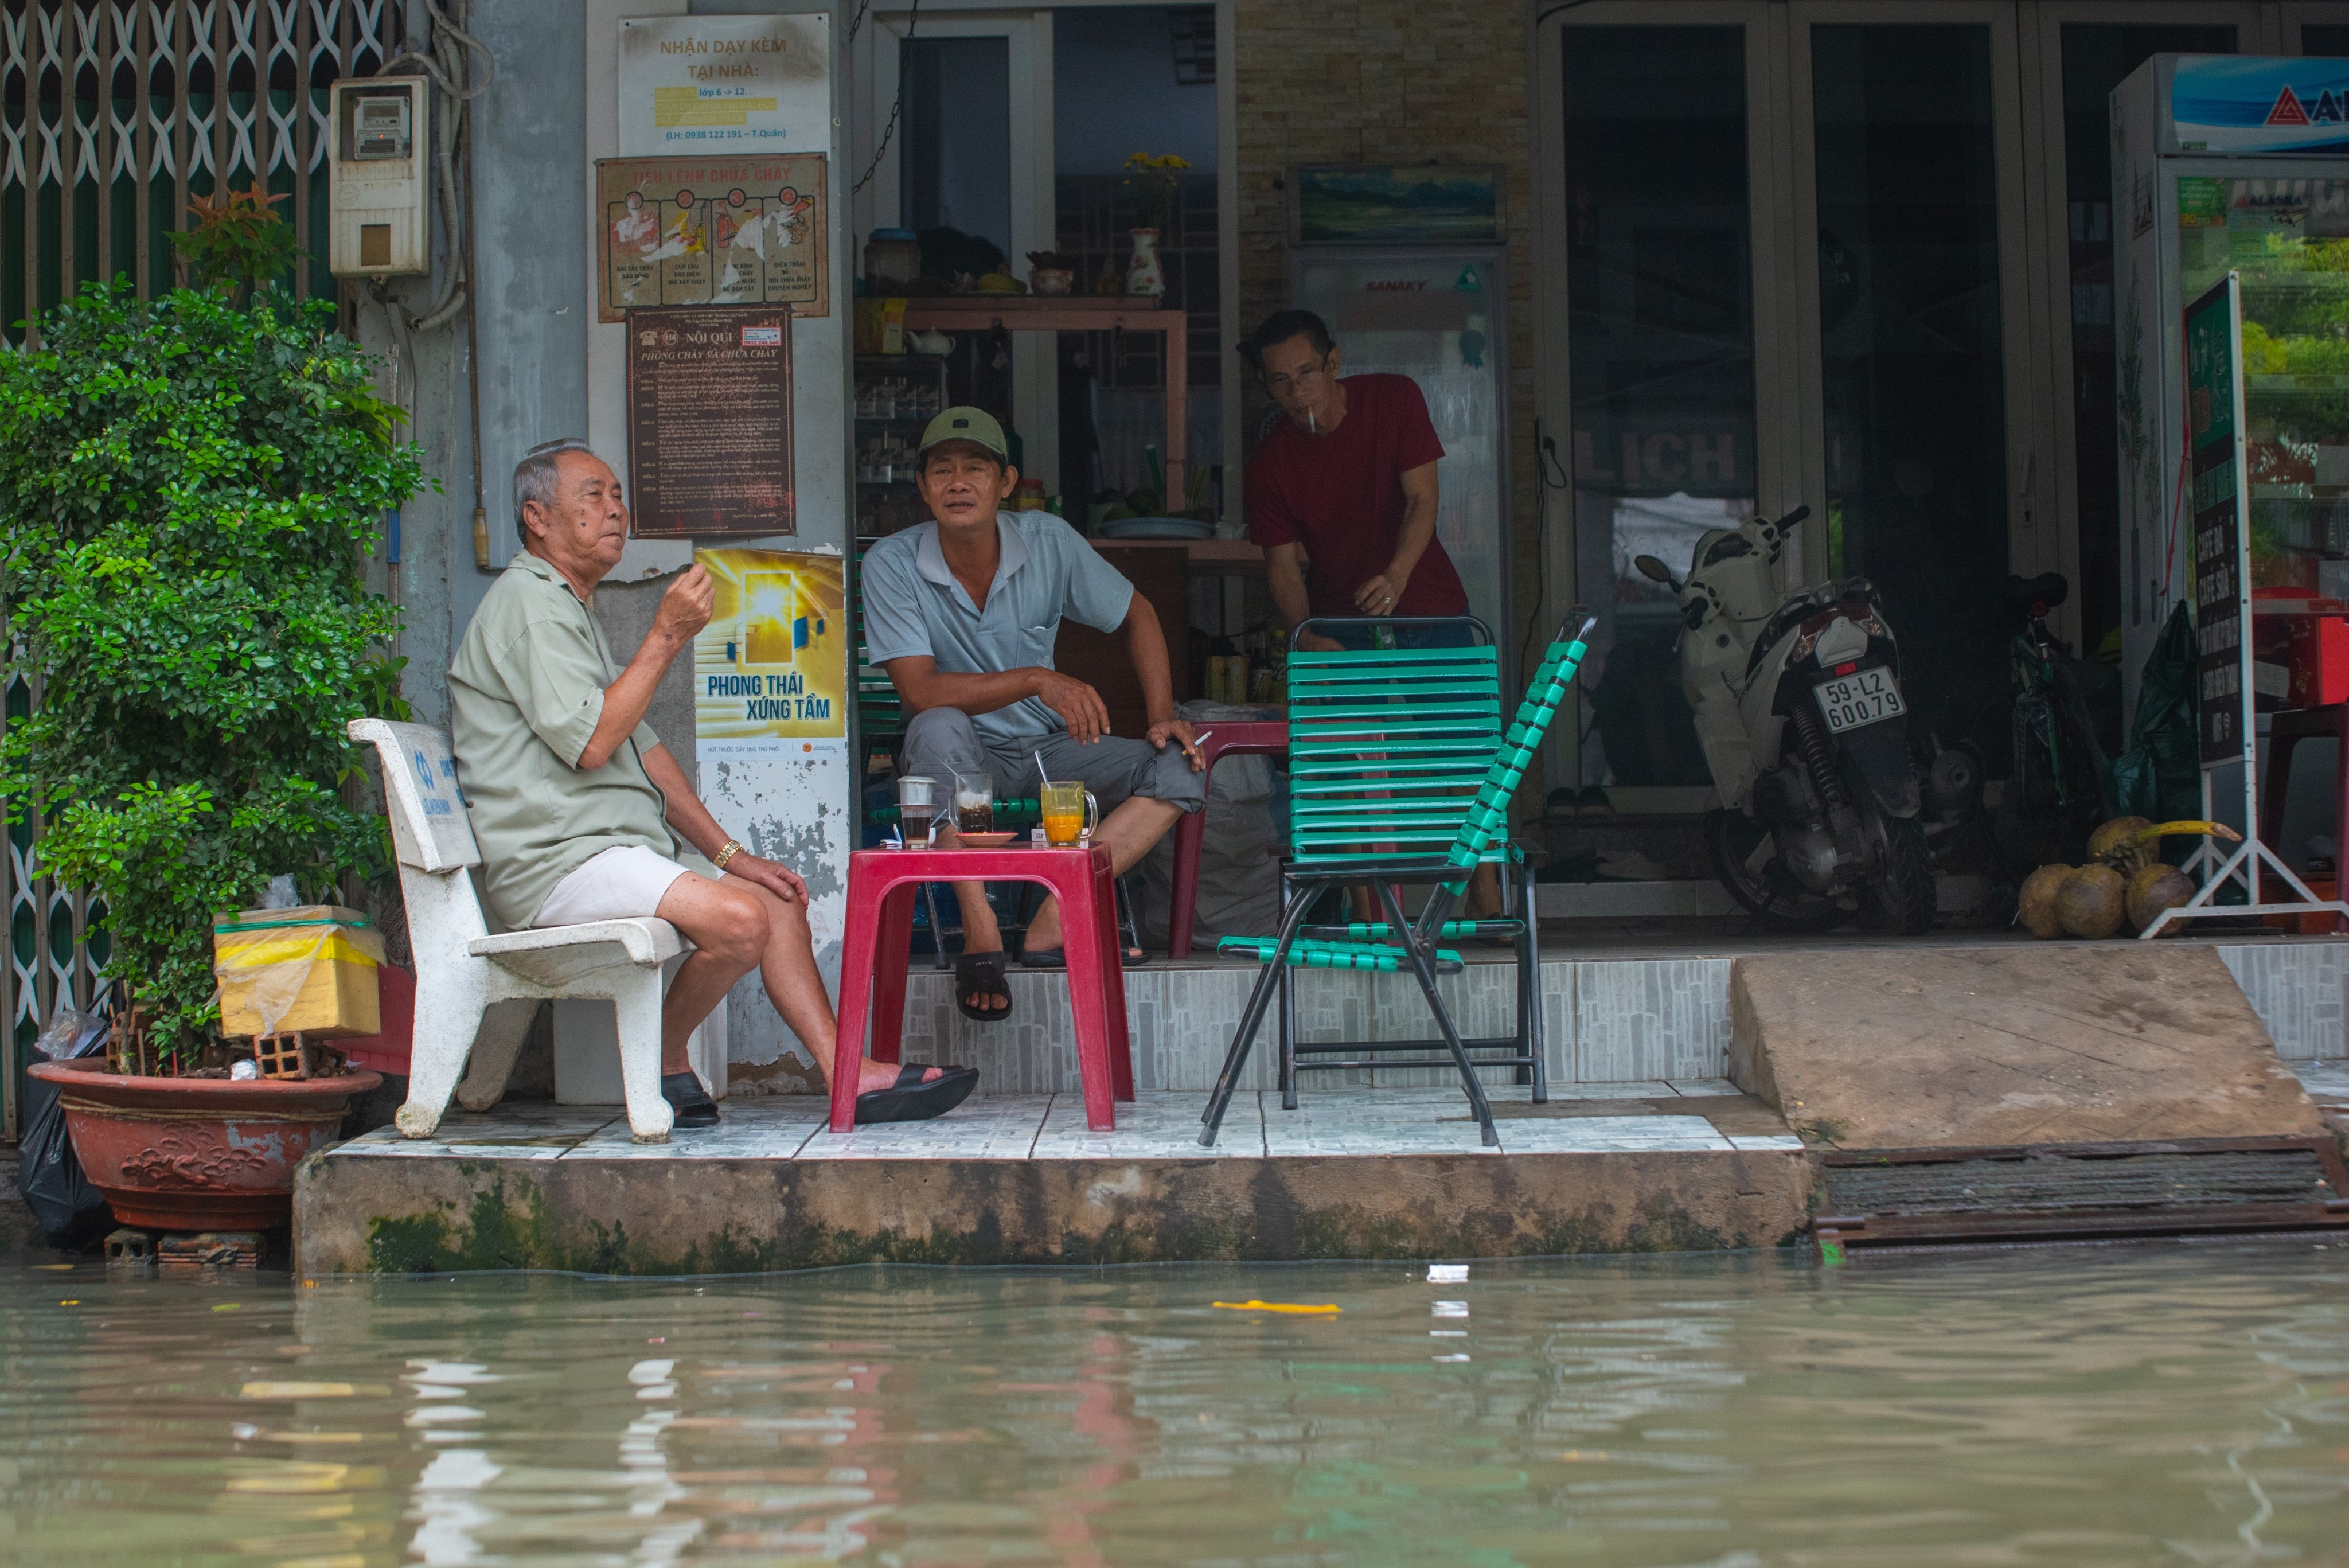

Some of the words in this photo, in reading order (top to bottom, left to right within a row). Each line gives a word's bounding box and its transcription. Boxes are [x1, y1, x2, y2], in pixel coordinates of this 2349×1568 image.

[660, 37, 707, 56] NHẬN
[713, 40, 746, 56] DẠY
[751, 36, 787, 53] KÈM
[687, 65, 713, 81] TẠI
[719, 61, 759, 78] NHÀ:
[699, 88, 714, 97] lớp
[666, 131, 683, 141] (LH:
[709, 131, 724, 139] 122
[727, 130, 742, 138] 191
[752, 128, 786, 138] T.Quân)
[668, 167, 705, 184] LỆNH
[710, 167, 750, 183] CHỮA
[754, 165, 790, 181] CHÁY
[680, 192, 691, 205] 2
[731, 192, 742, 205] 3
[780, 189, 793, 202] 4
[2249, 195, 2301, 206] ALASKA
[1366, 280, 1427, 292] SANAKY
[665, 333, 676, 341] 114
[686, 330, 707, 344] NỘI
[677, 349, 704, 360] CHÁY
[721, 346, 747, 359] CHỮA
[750, 348, 778, 358] CHÁY
[708, 676, 762, 697] PHONG
[766, 671, 803, 695] THÁI
[1825, 673, 1884, 704] 59-L2
[747, 696, 791, 720] XỨNG
[795, 692, 830, 719] TẦM
[1828, 692, 1899, 728] 600.79
[719, 744, 734, 752] THUỐC
[735, 744, 745, 752] GÂY
[769, 743, 780, 752] PHỔI
